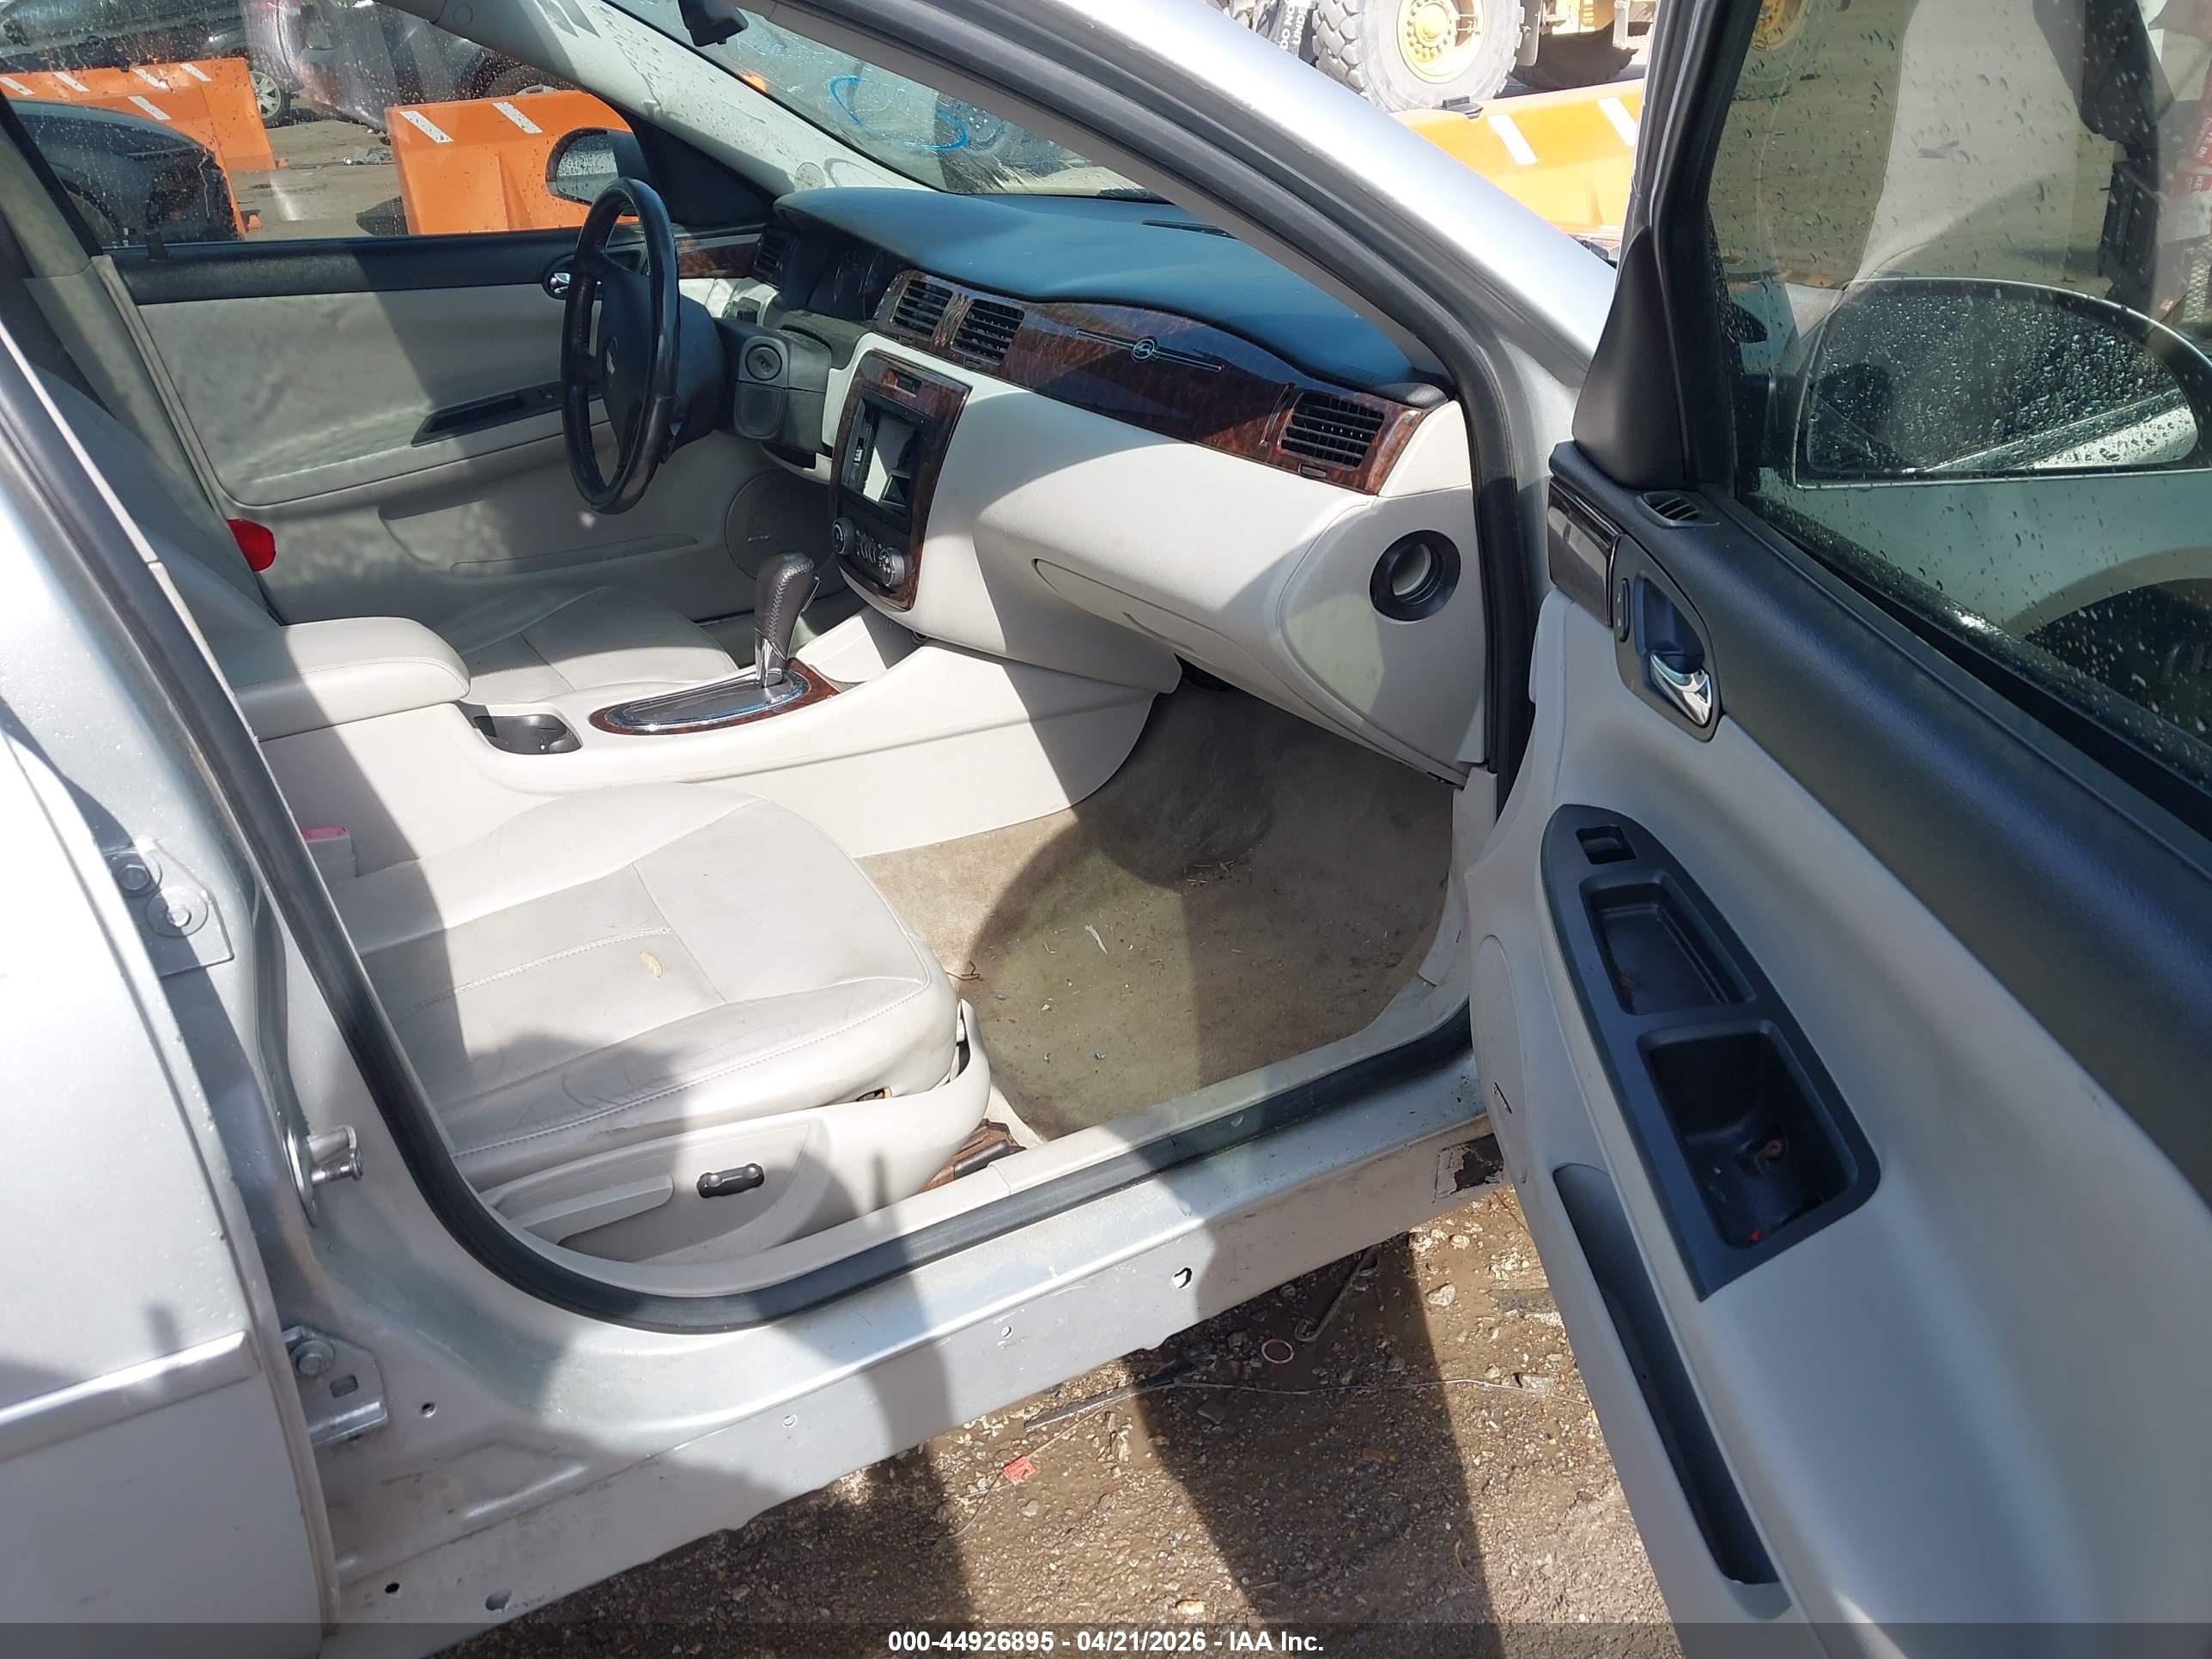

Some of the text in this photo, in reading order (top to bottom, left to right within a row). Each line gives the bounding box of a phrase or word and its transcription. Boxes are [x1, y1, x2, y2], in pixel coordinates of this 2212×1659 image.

[1279, 0, 1297, 50] DO NO
[1292, 3, 1307, 45] UNDE
